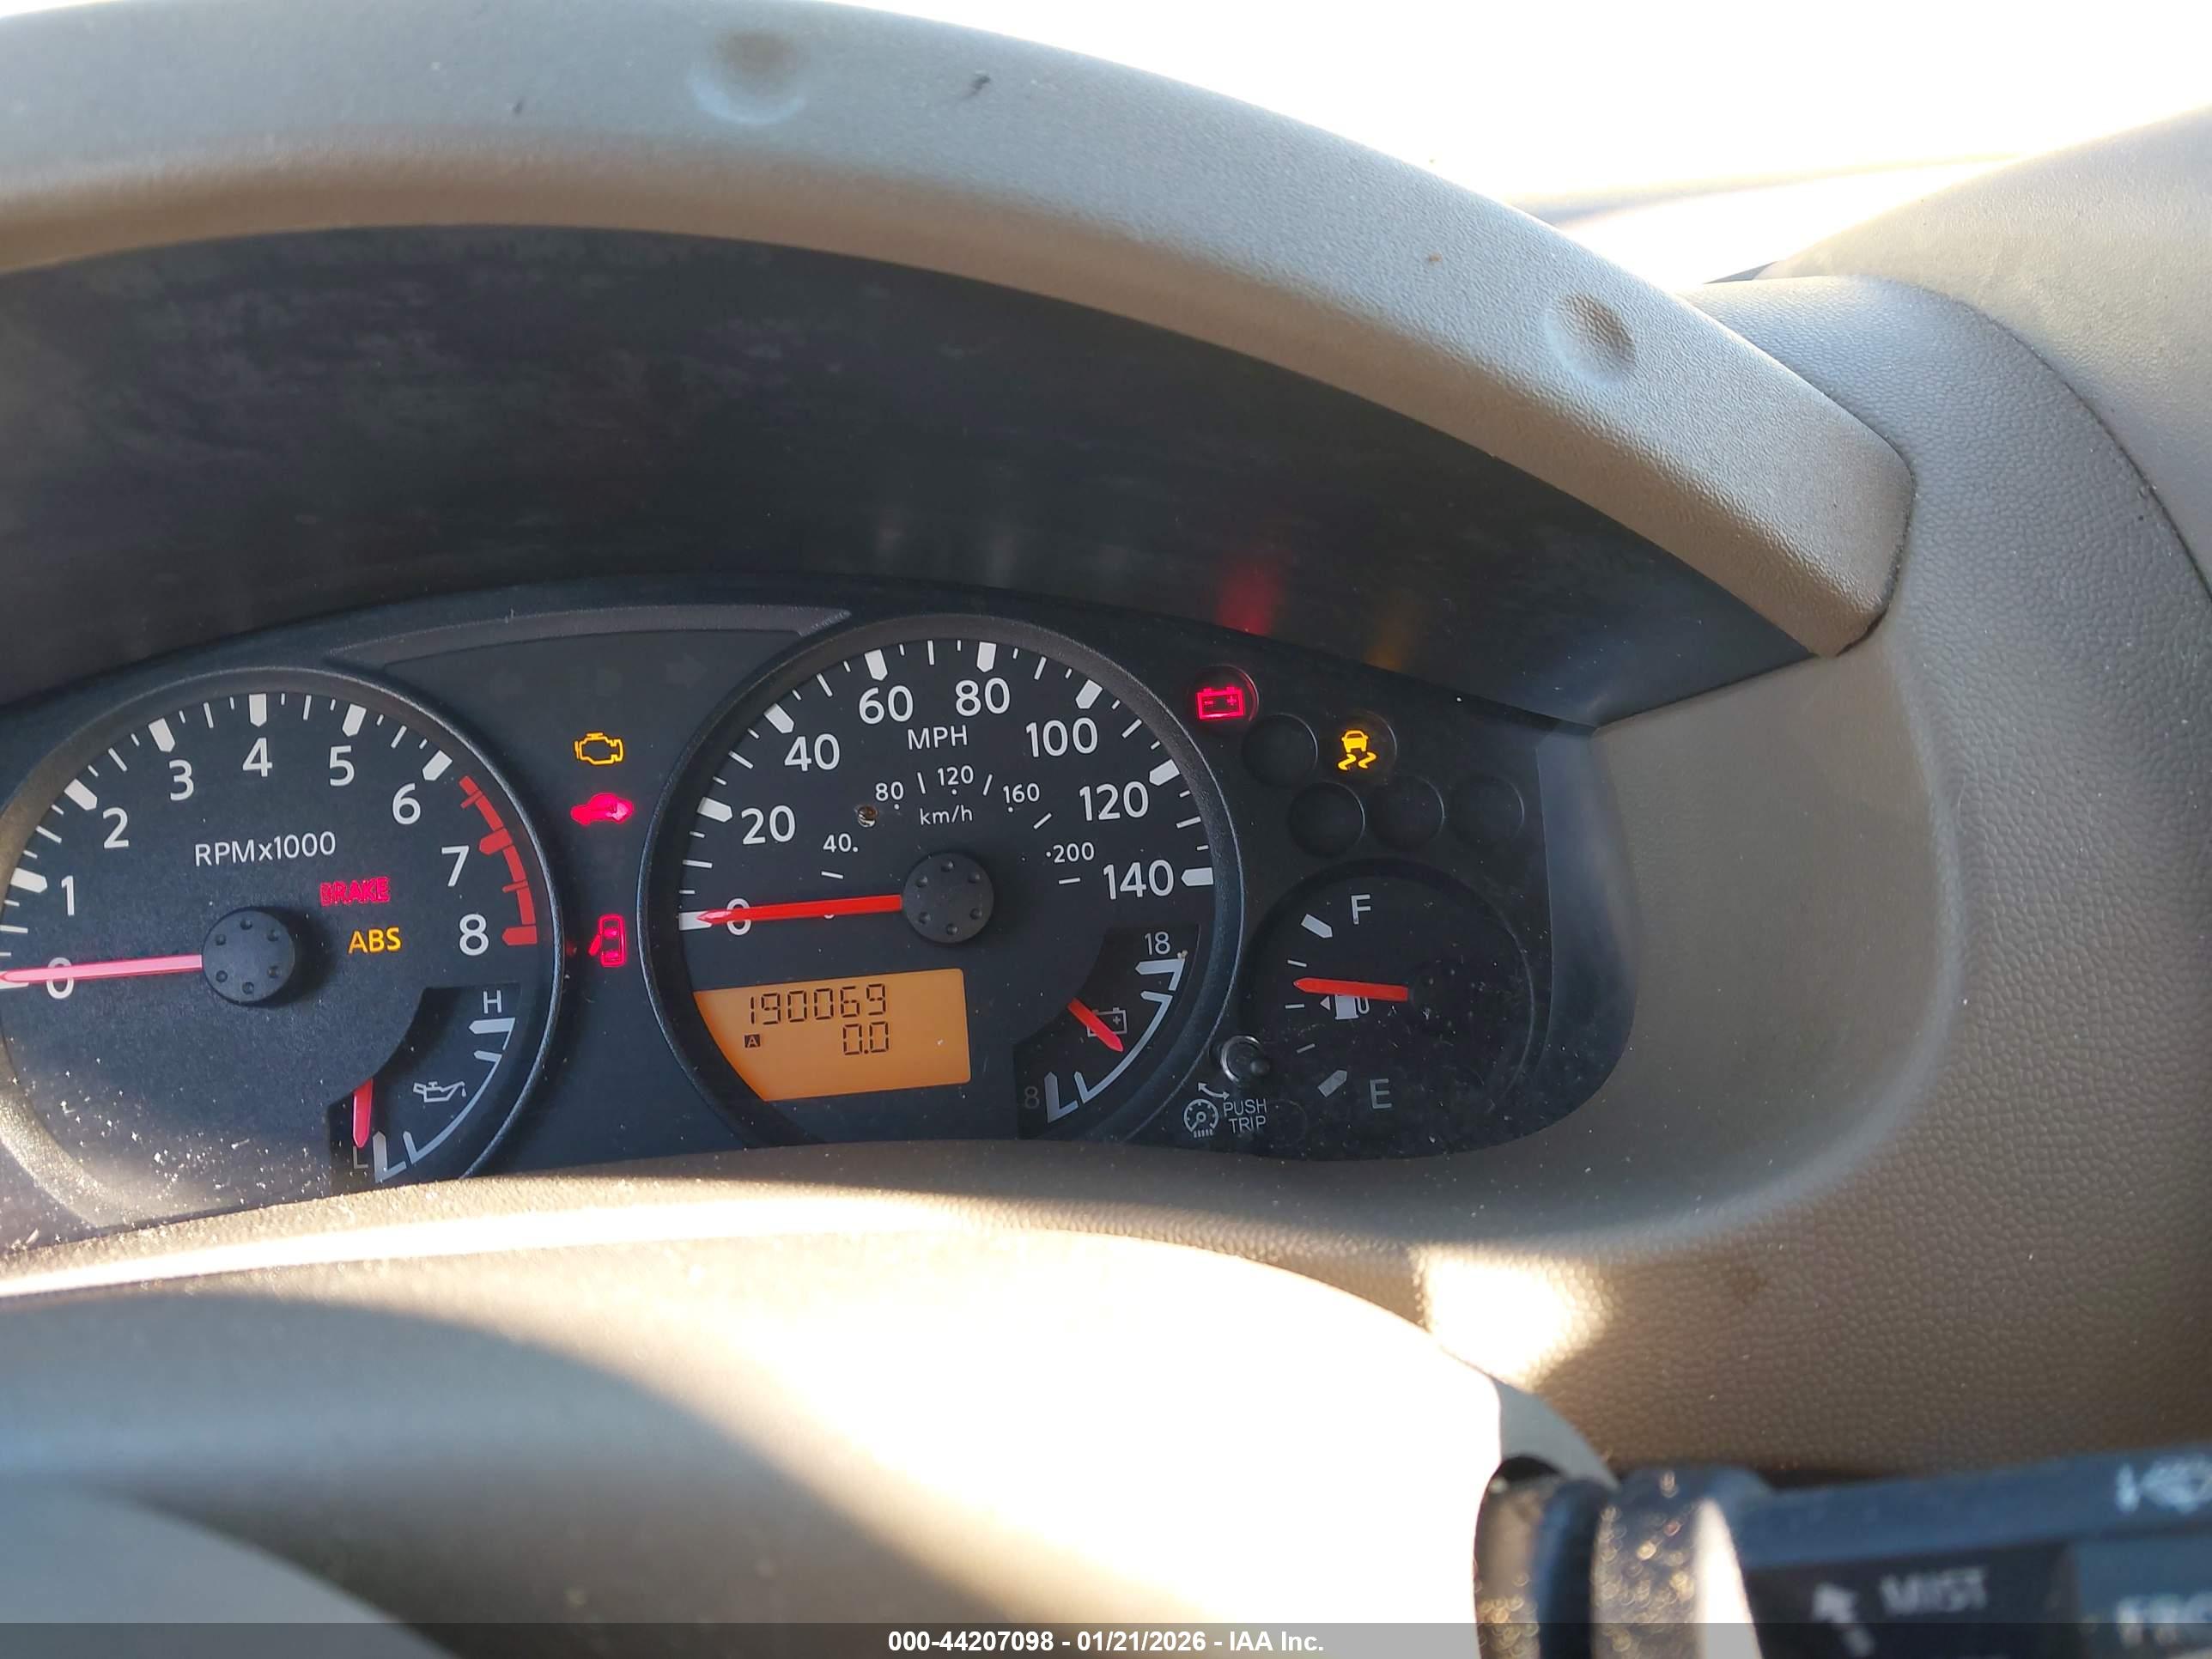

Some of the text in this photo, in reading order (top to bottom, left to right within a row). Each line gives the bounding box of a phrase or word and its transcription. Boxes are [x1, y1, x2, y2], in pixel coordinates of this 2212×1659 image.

[858, 685, 914, 725] 60
[955, 678, 1011, 716] 80
[784, 733, 841, 773] 40
[907, 725, 969, 750] MPH
[1025, 716, 1098, 758] 100
[242, 737, 273, 777] 4
[328, 745, 355, 787] 5
[170, 760, 194, 801] 3
[874, 781, 904, 802] 80
[937, 766, 975, 786] 120
[1003, 782, 1041, 804] 160
[392, 783, 421, 825] 6
[919, 805, 974, 826] km/h
[1079, 782, 1149, 822] 120
[102, 806, 130, 849] 2
[741, 805, 796, 846] 20
[194, 830, 337, 867] RPMx1000
[441, 845, 471, 887] 7
[1053, 842, 1095, 864] 200
[61, 875, 76, 916] 1
[319, 876, 391, 907] BRAKE
[1103, 860, 1175, 901] 140
[726, 897, 751, 936] 0
[1351, 894, 1371, 925] F
[347, 926, 402, 955] ABS
[459, 913, 489, 957] 8
[1145, 932, 1170, 956] 18
[46, 957, 75, 1000] 0
[483, 990, 502, 1014] H
[749, 982, 886, 1026] 190069
[842, 1020, 890, 1056] 0.0
[1024, 1086, 1040, 1109] 8
[1223, 1098, 1267, 1117] PUSH
[1370, 1078, 1393, 1110] E
[1228, 1115, 1267, 1134] TRIP
[353, 1146, 369, 1169] L
